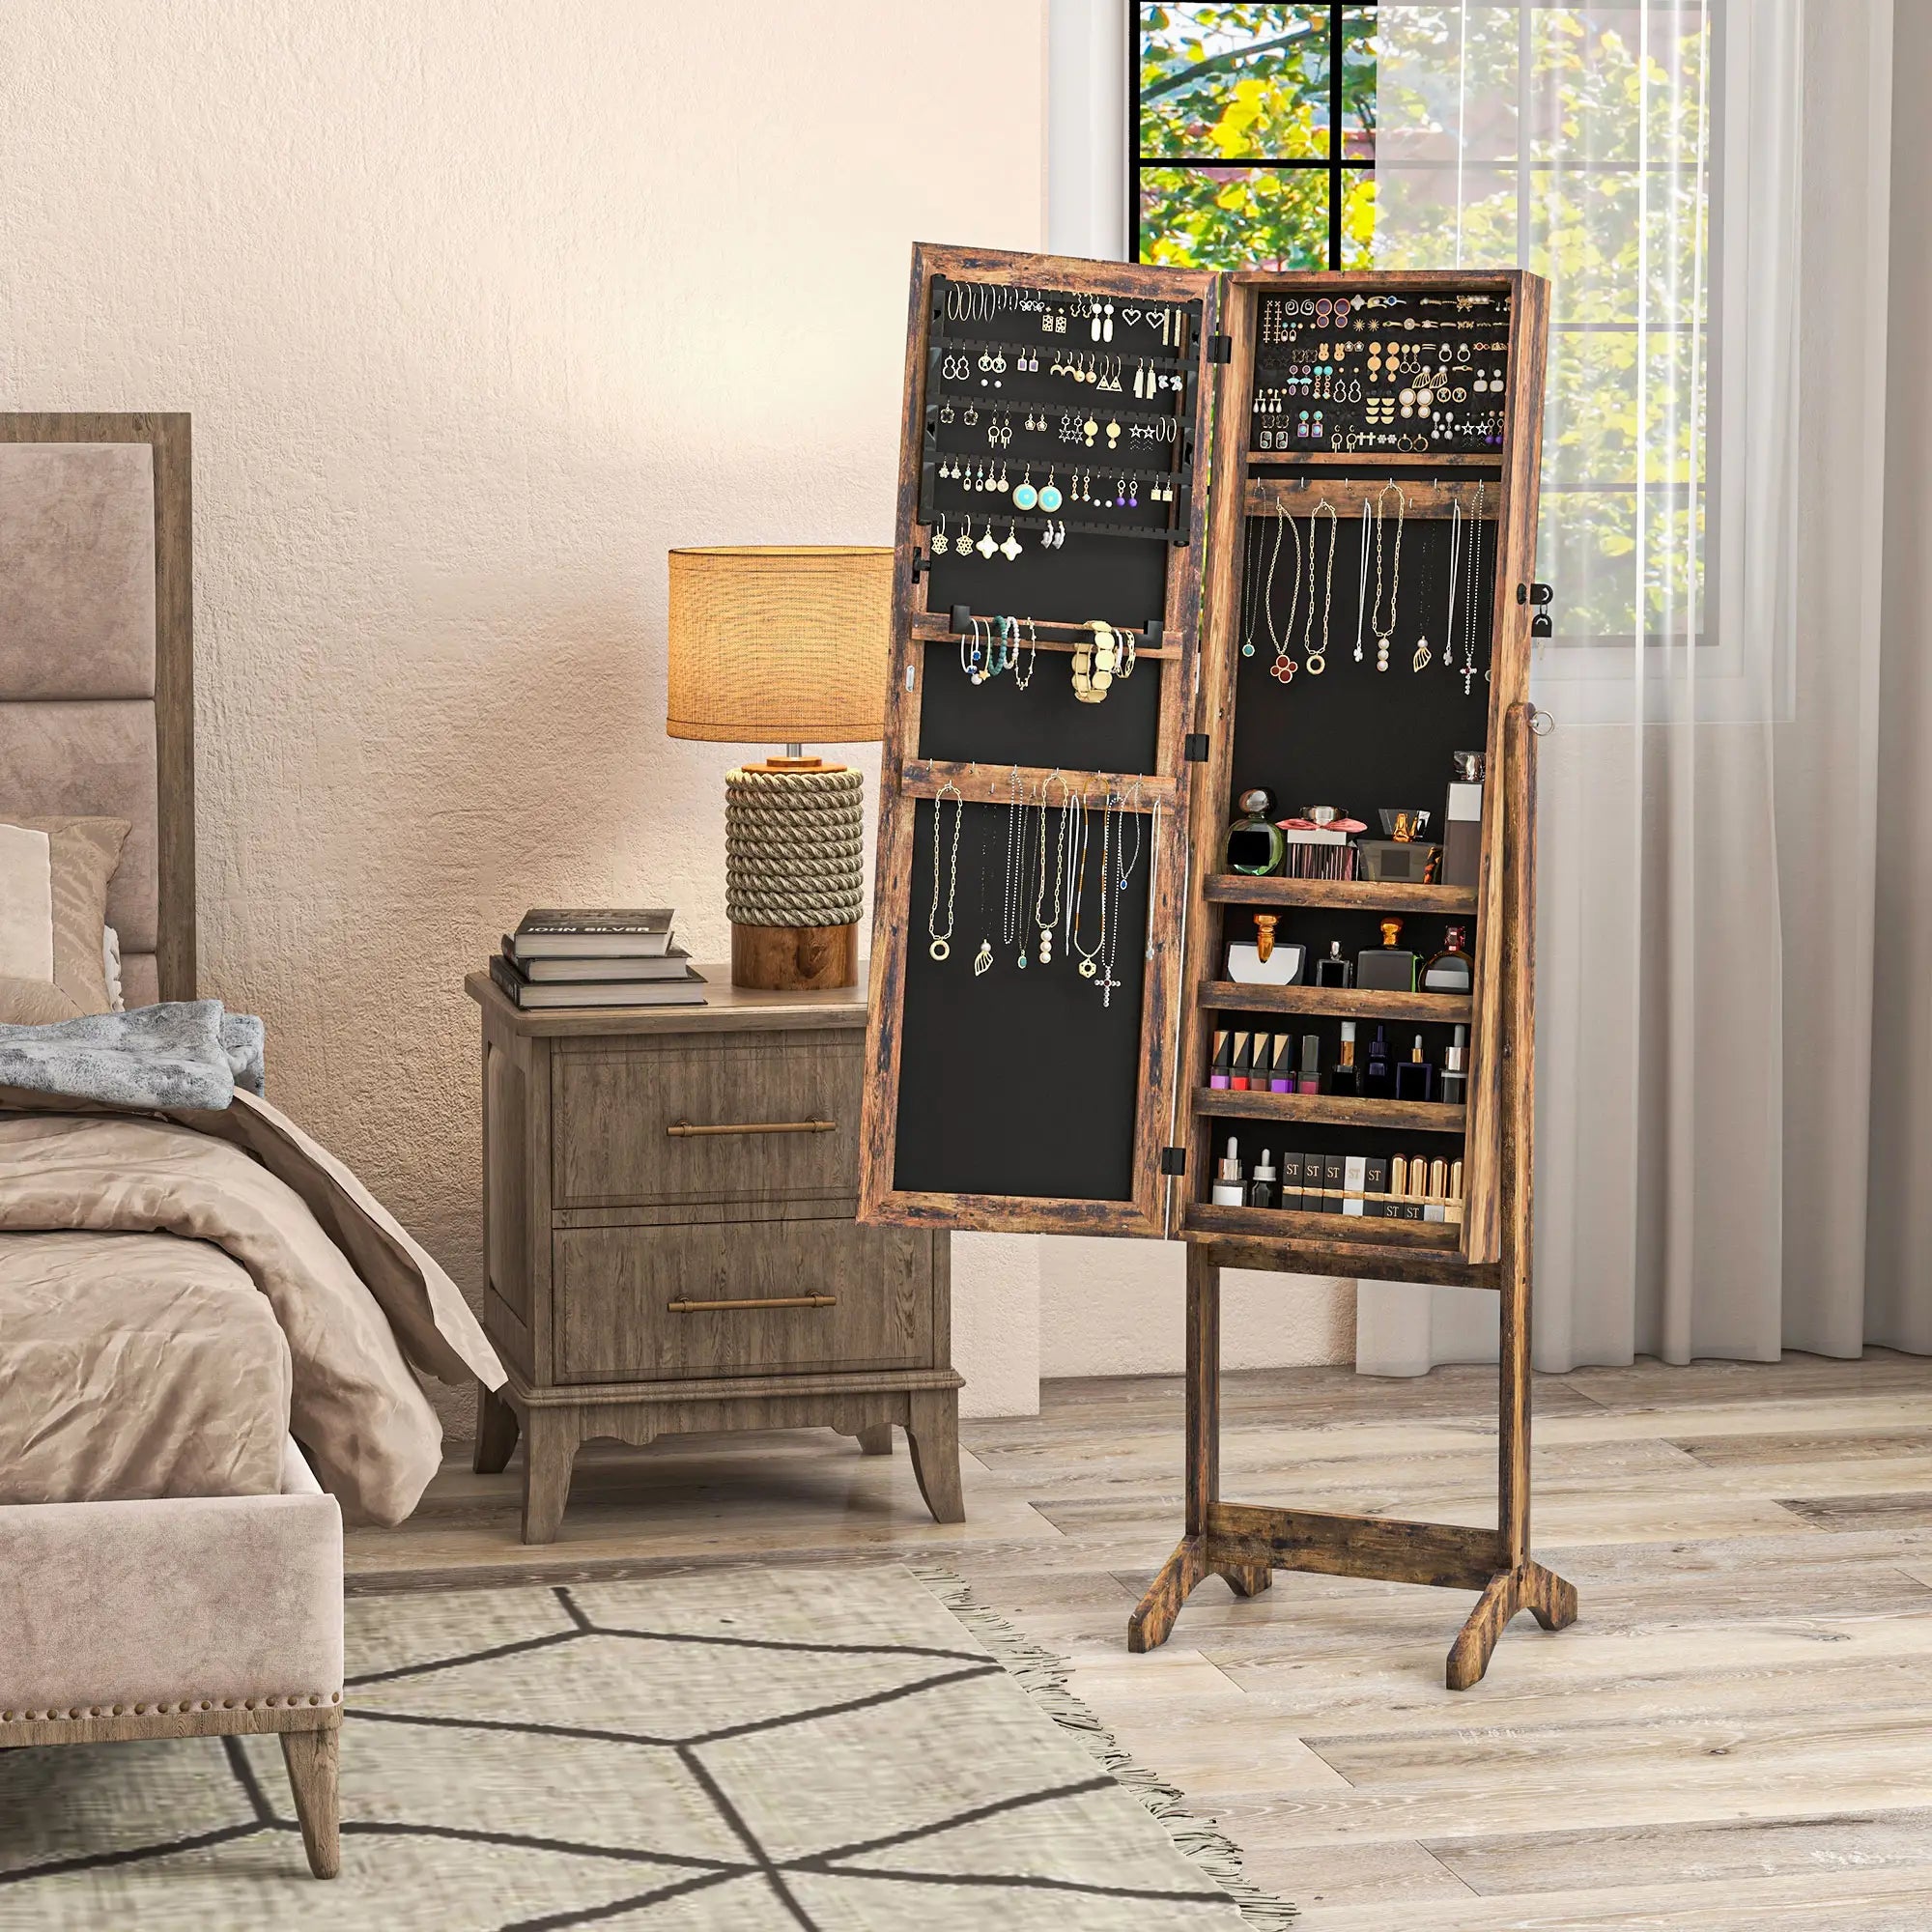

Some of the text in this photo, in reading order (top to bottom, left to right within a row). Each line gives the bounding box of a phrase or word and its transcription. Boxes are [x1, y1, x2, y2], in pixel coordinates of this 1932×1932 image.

[1286, 1164, 1299, 1175] ST
[1307, 1165, 1320, 1177] ST
[1327, 1167, 1340, 1179] ST
[1368, 1170, 1380, 1181] ST
[1386, 1206, 1399, 1217] ST
[1406, 1208, 1420, 1218] ST
